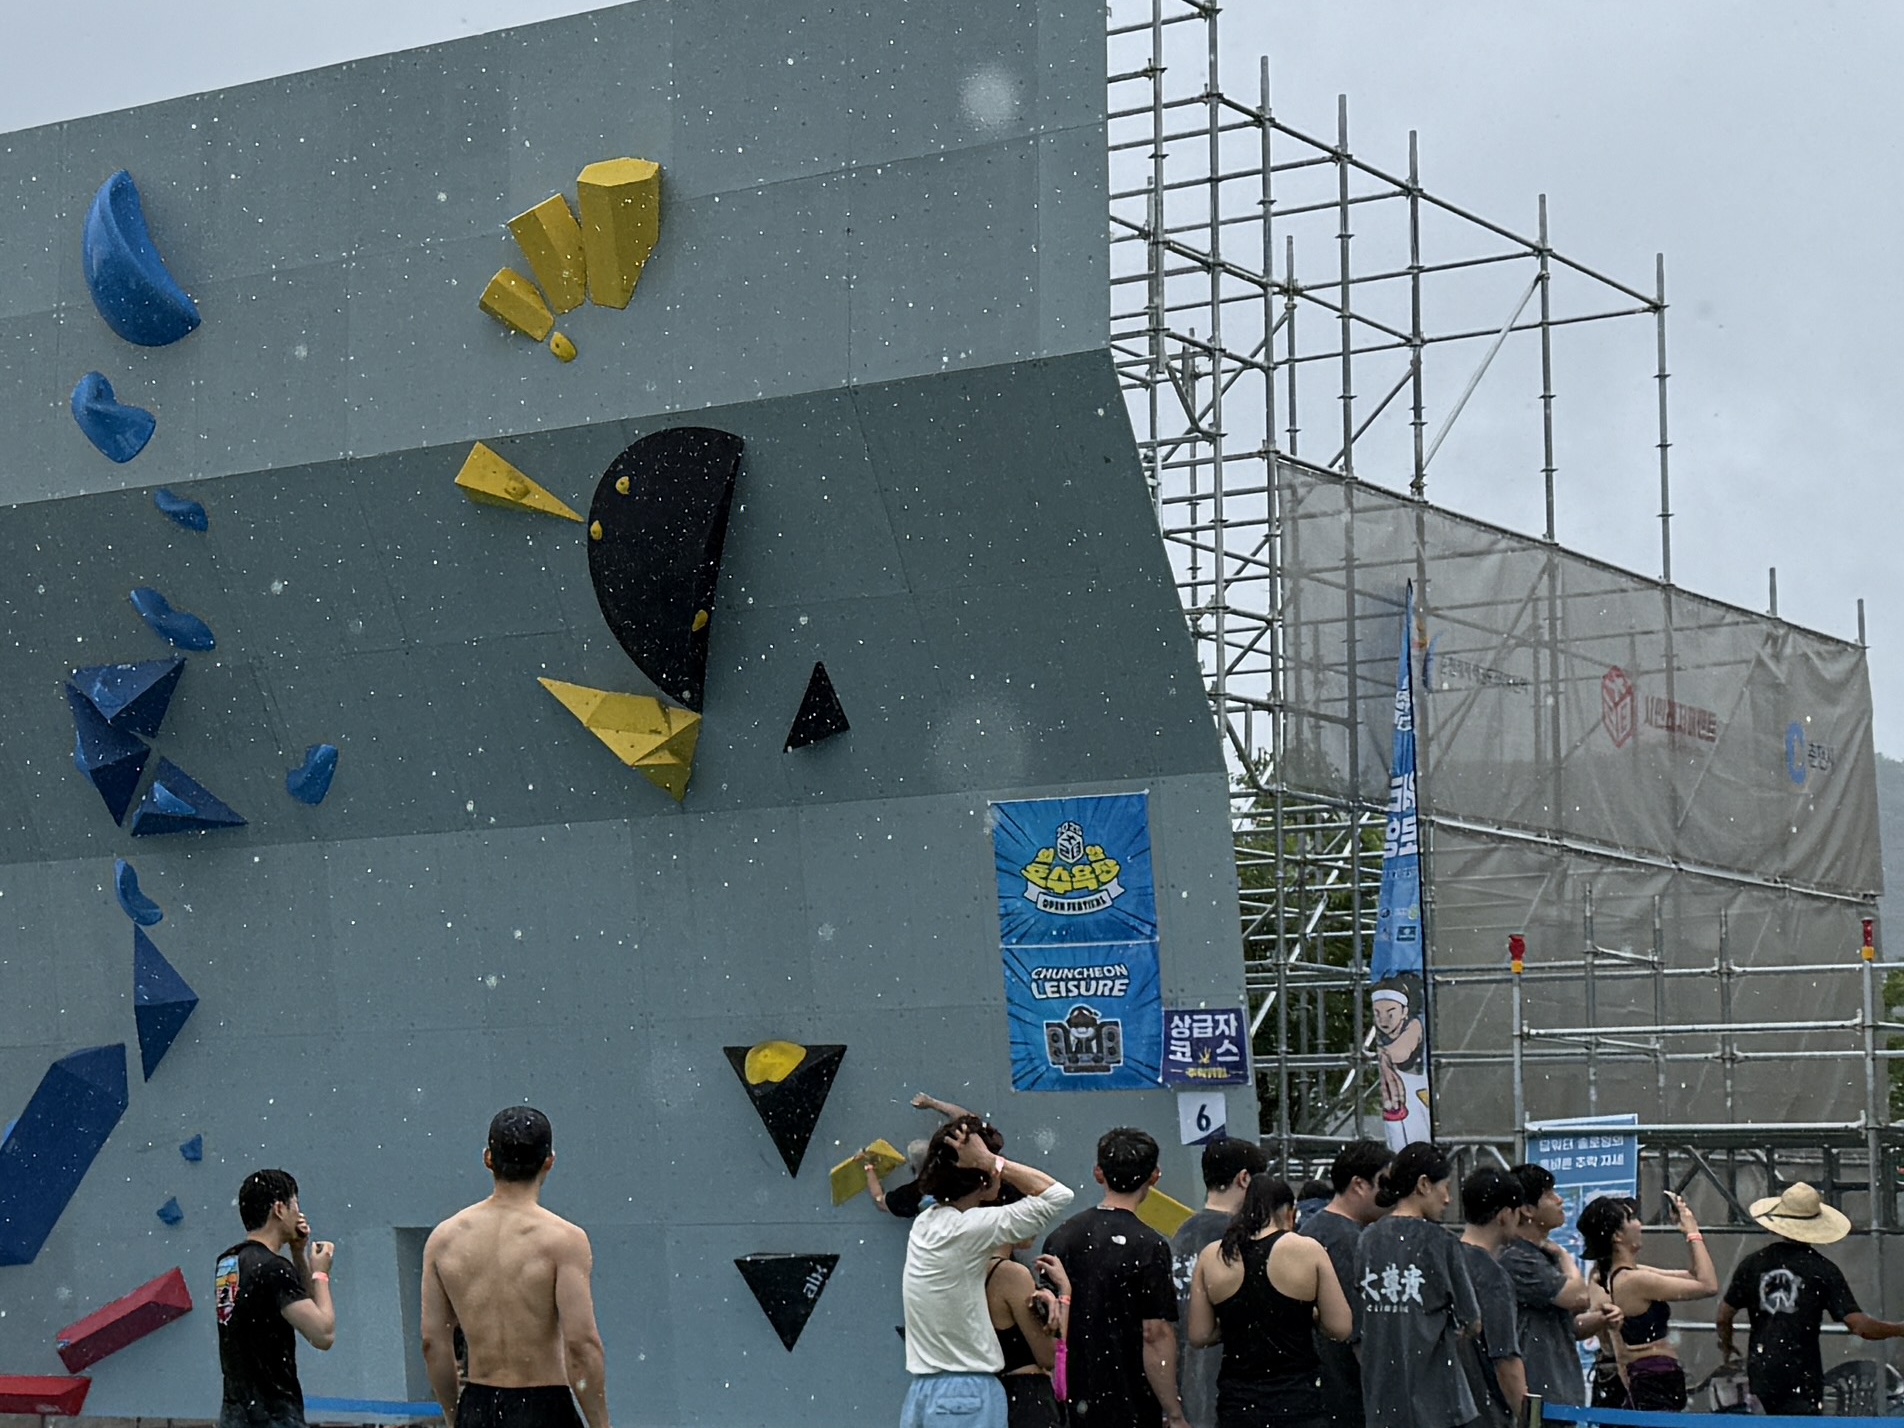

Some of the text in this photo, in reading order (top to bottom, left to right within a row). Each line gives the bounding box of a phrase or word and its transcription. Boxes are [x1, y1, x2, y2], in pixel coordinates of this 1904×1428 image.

[1020, 858, 1121, 895] 호수욕장
[1031, 964, 1128, 979] CHUNCHEON
[1032, 978, 1130, 999] LEISURE
[1170, 1013, 1238, 1039] 상급자
[1197, 1104, 1211, 1132] 6
[803, 1264, 828, 1298] aix
